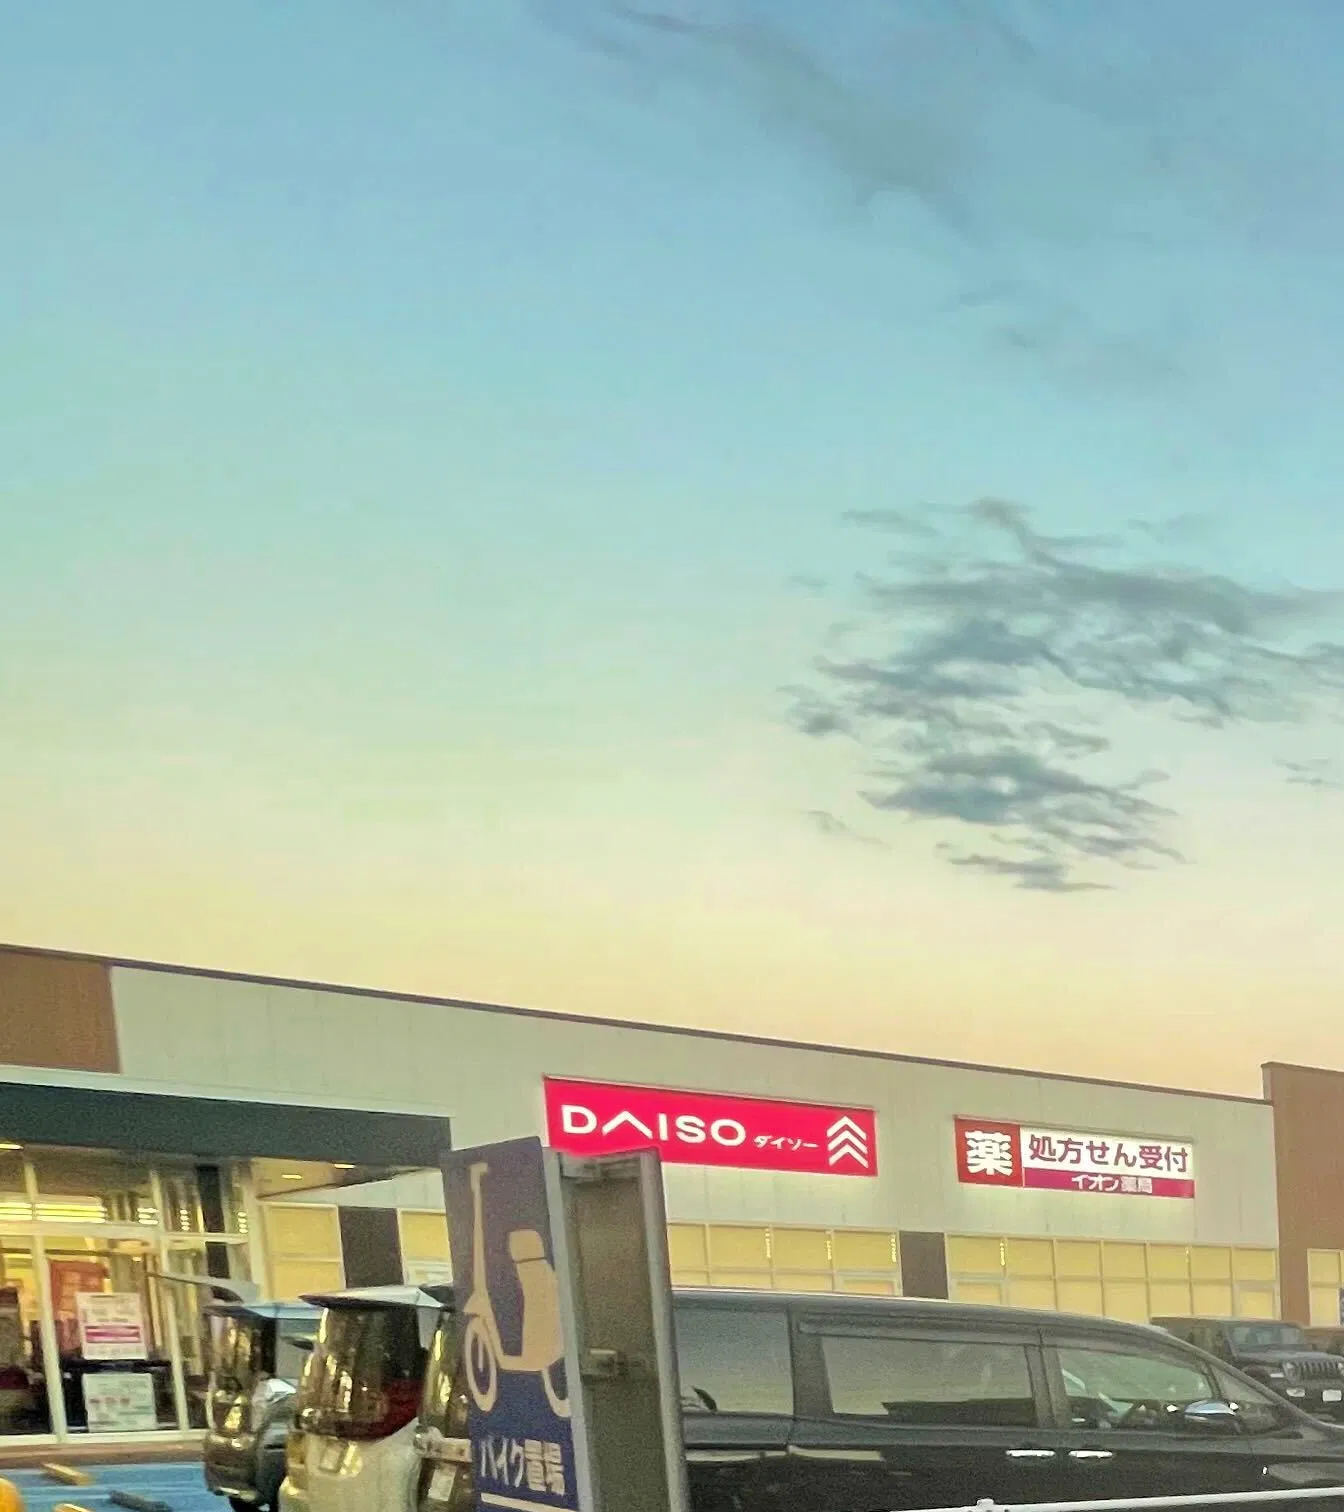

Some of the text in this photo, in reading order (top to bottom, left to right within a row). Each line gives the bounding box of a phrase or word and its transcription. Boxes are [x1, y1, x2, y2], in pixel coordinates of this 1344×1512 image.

[561, 1105, 819, 1151] DAISO ダイソー
[965, 1129, 1013, 1177] 薬
[1029, 1134, 1188, 1172] 処方せん受付
